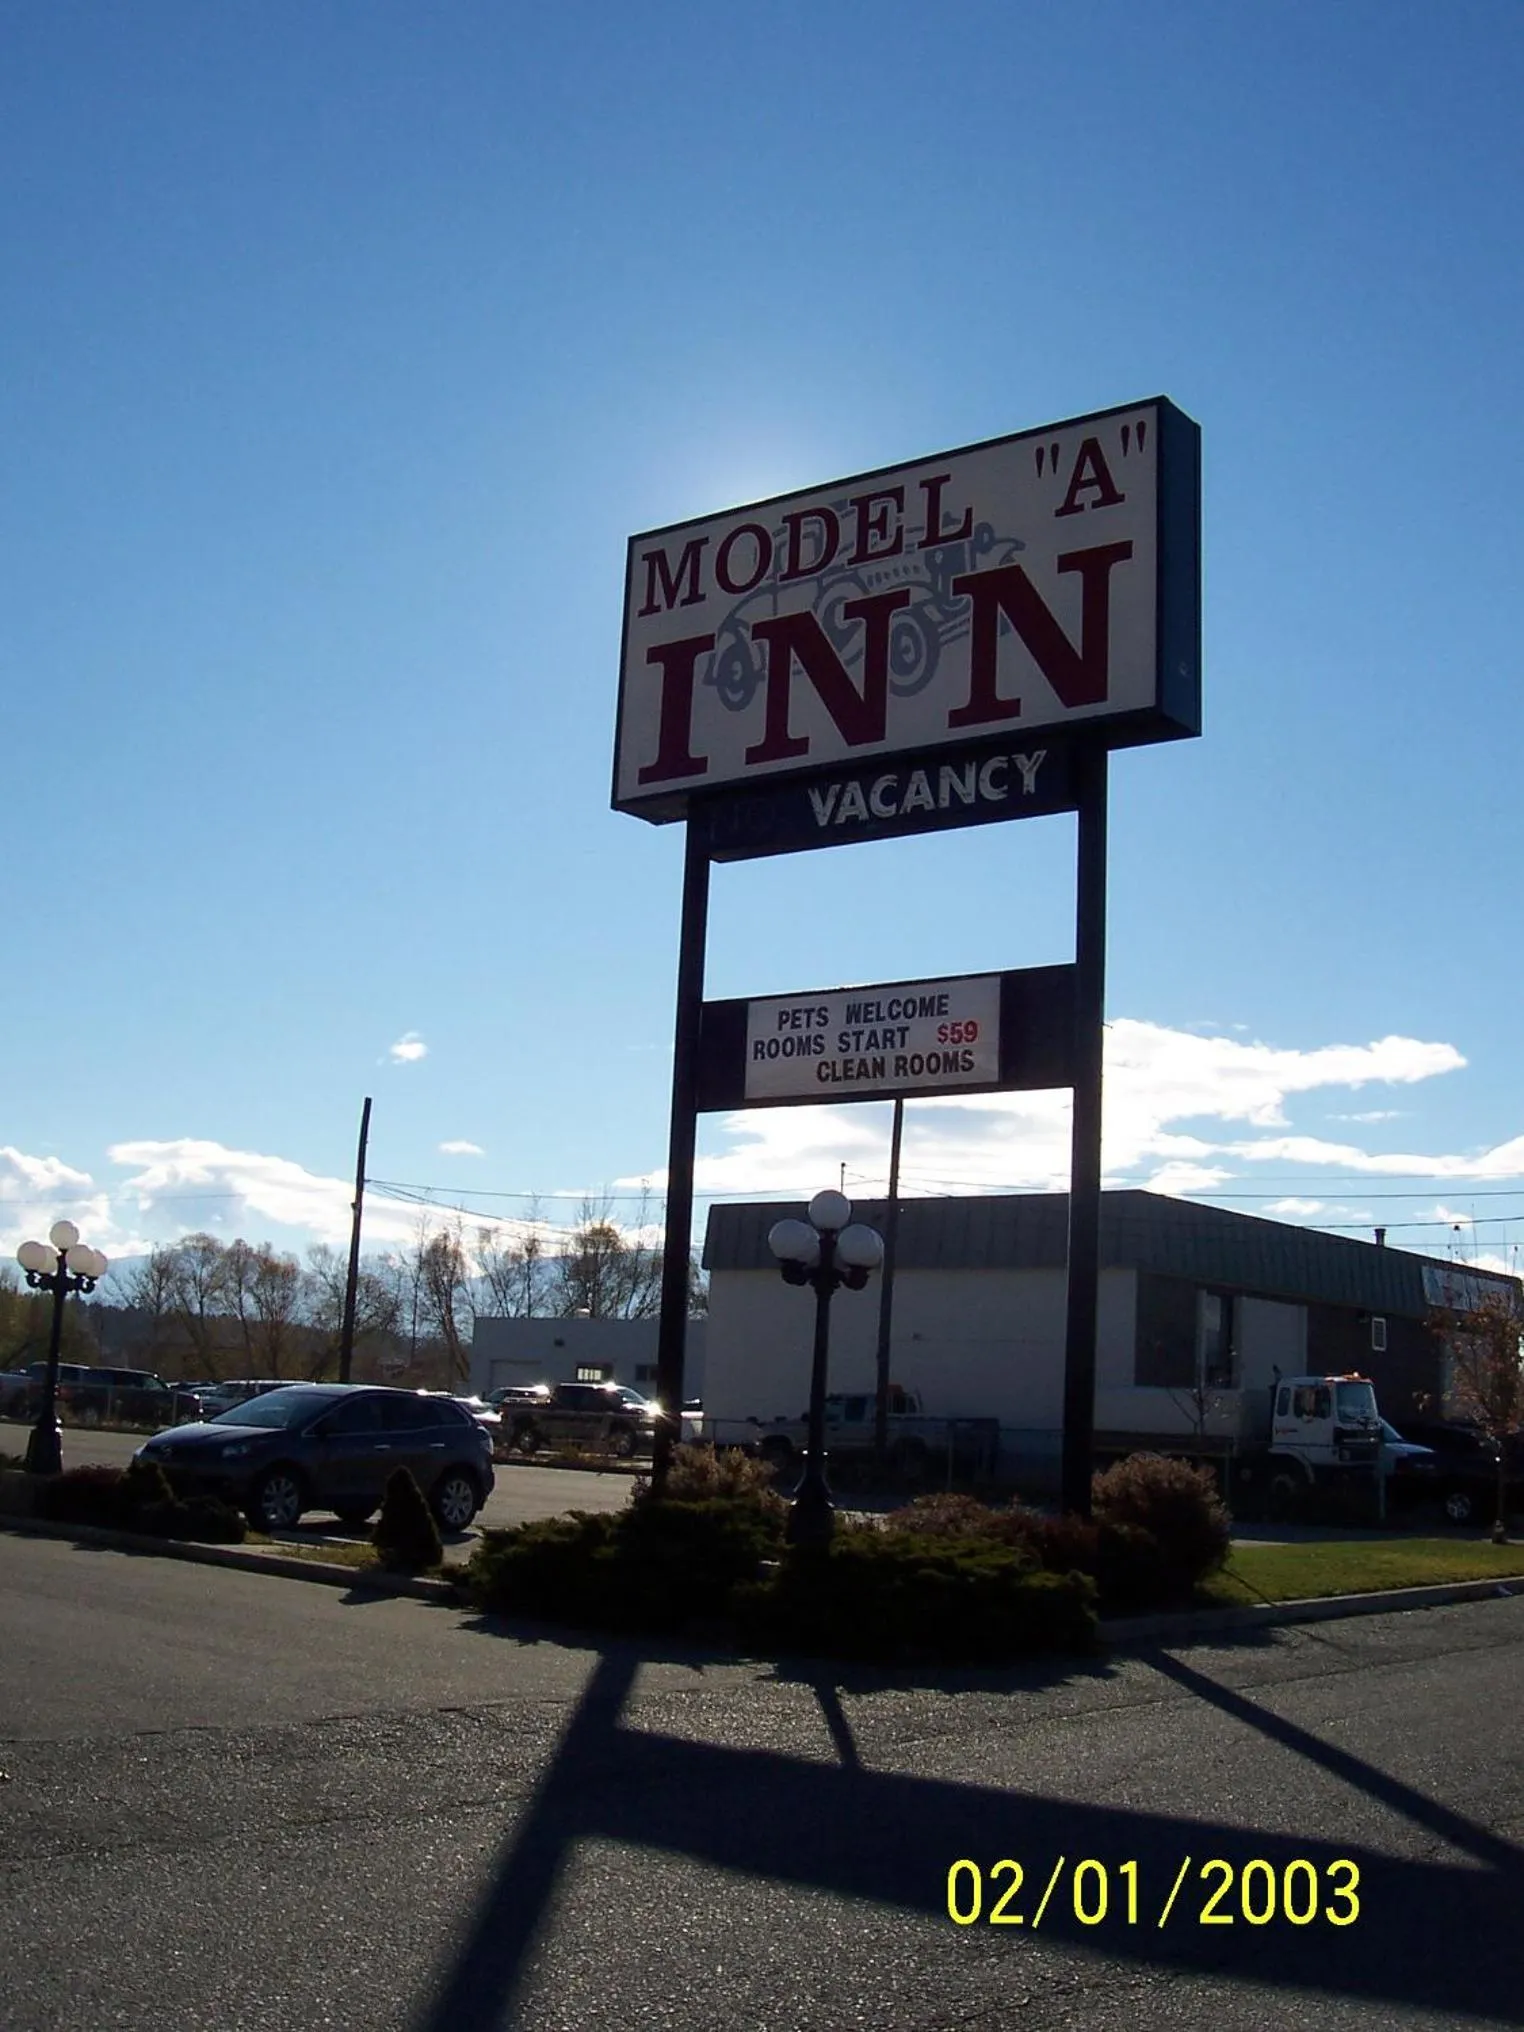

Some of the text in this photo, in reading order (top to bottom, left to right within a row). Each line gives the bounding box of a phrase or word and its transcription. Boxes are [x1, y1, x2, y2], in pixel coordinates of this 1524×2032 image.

[637, 420, 1147, 618] MODEL "A"
[637, 540, 1134, 785] INN
[807, 749, 1047, 827] VACANCY
[753, 1020, 978, 1060] ROOMS START $59
[778, 994, 950, 1031] PETS WELCOME
[817, 1049, 975, 1083] CLEAN ROOMS
